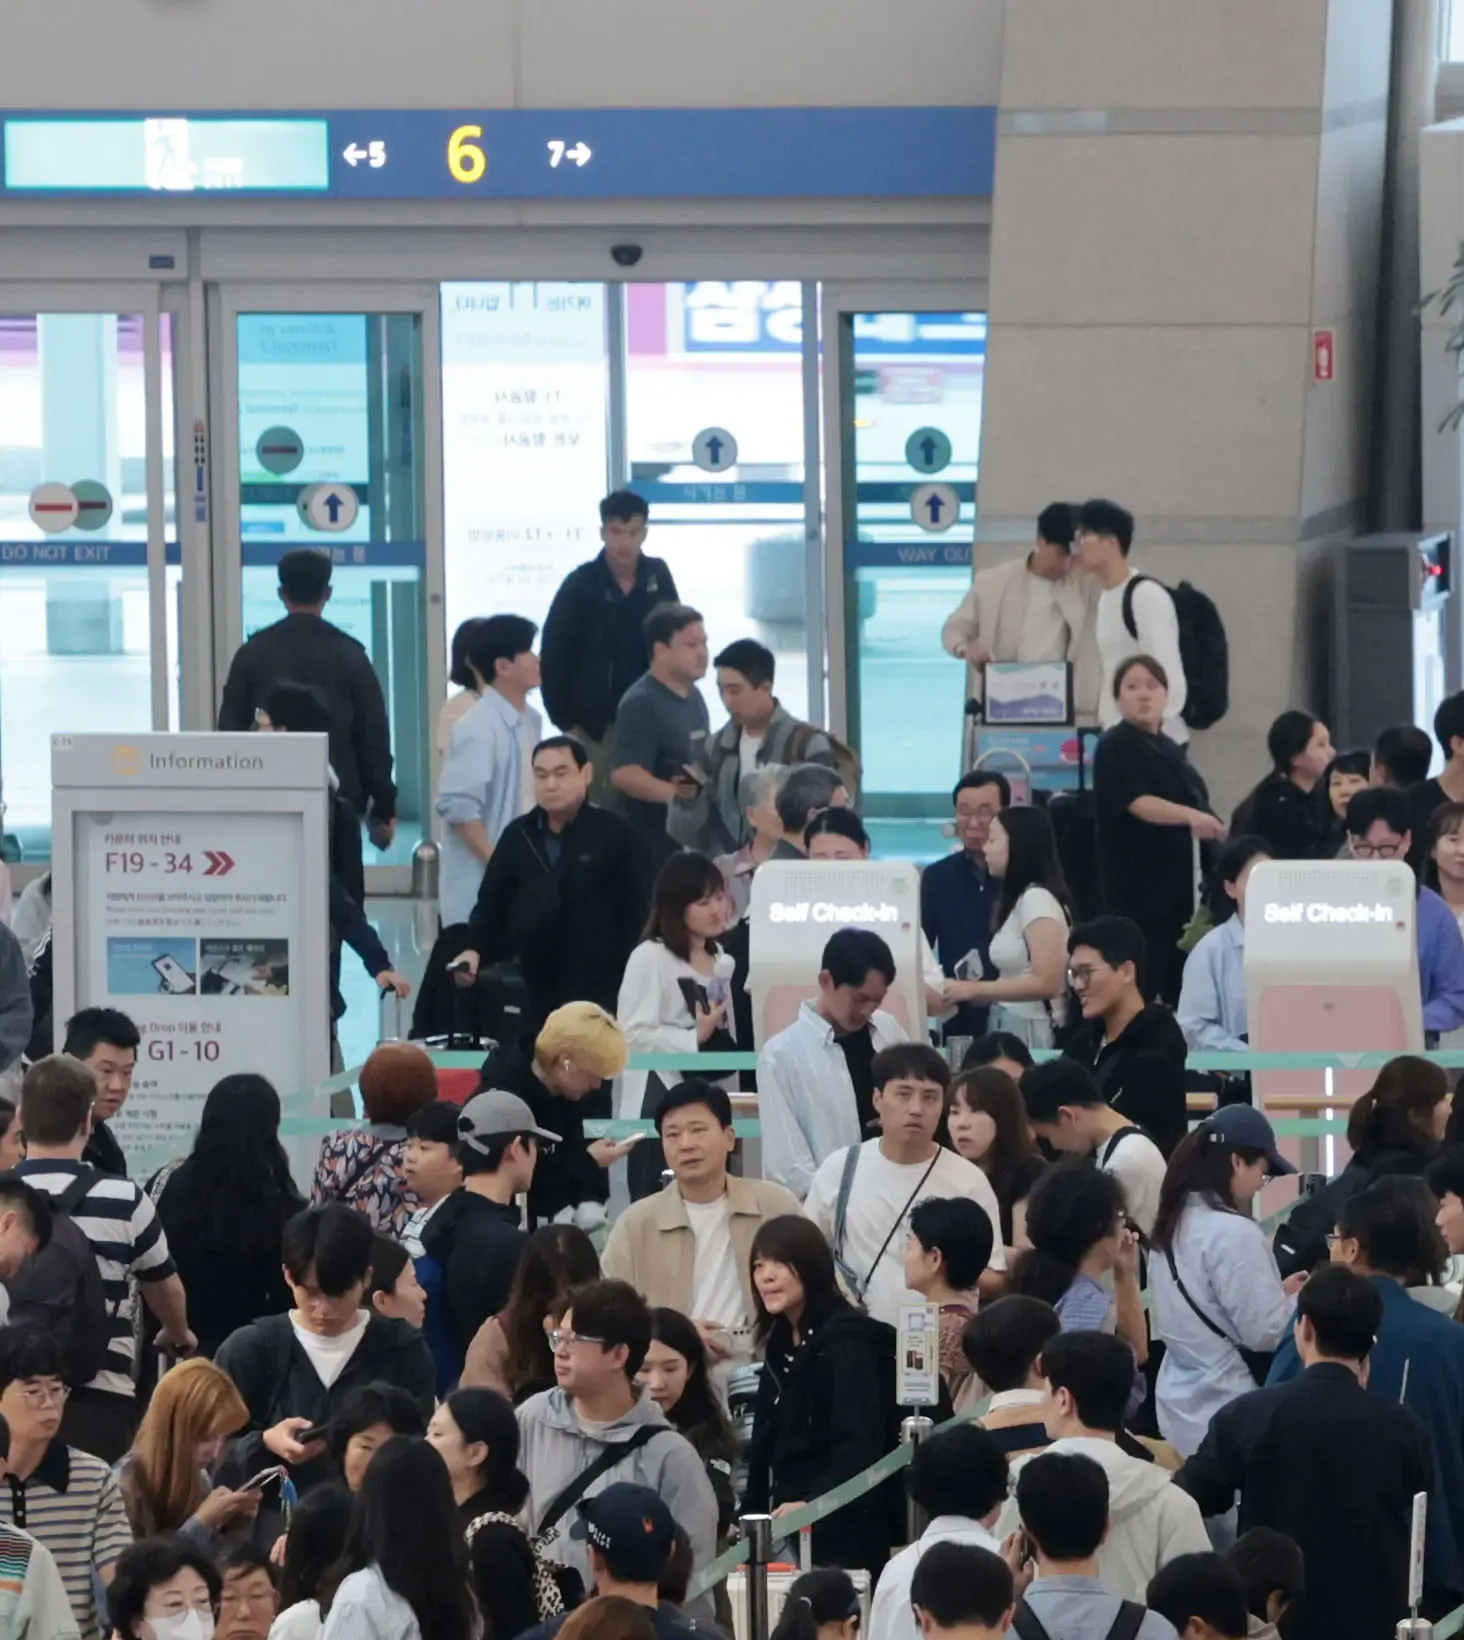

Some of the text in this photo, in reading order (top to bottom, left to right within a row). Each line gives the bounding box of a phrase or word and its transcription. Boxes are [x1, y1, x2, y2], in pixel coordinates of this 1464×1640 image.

[368, 141, 387, 168] 5
[446, 125, 487, 183] 6
[547, 141, 563, 168] 7
[2, 545, 111, 561] DO NOT EXIT
[897, 548, 972, 562] WAY OU
[150, 753, 264, 771] Information
[104, 853, 144, 873] F19
[164, 852, 194, 873] 34
[769, 902, 808, 922] Self
[1264, 902, 1303, 922] Self
[150, 1023, 177, 1034] Drop
[148, 1040, 174, 1062] G1
[194, 1040, 221, 1062] 10
